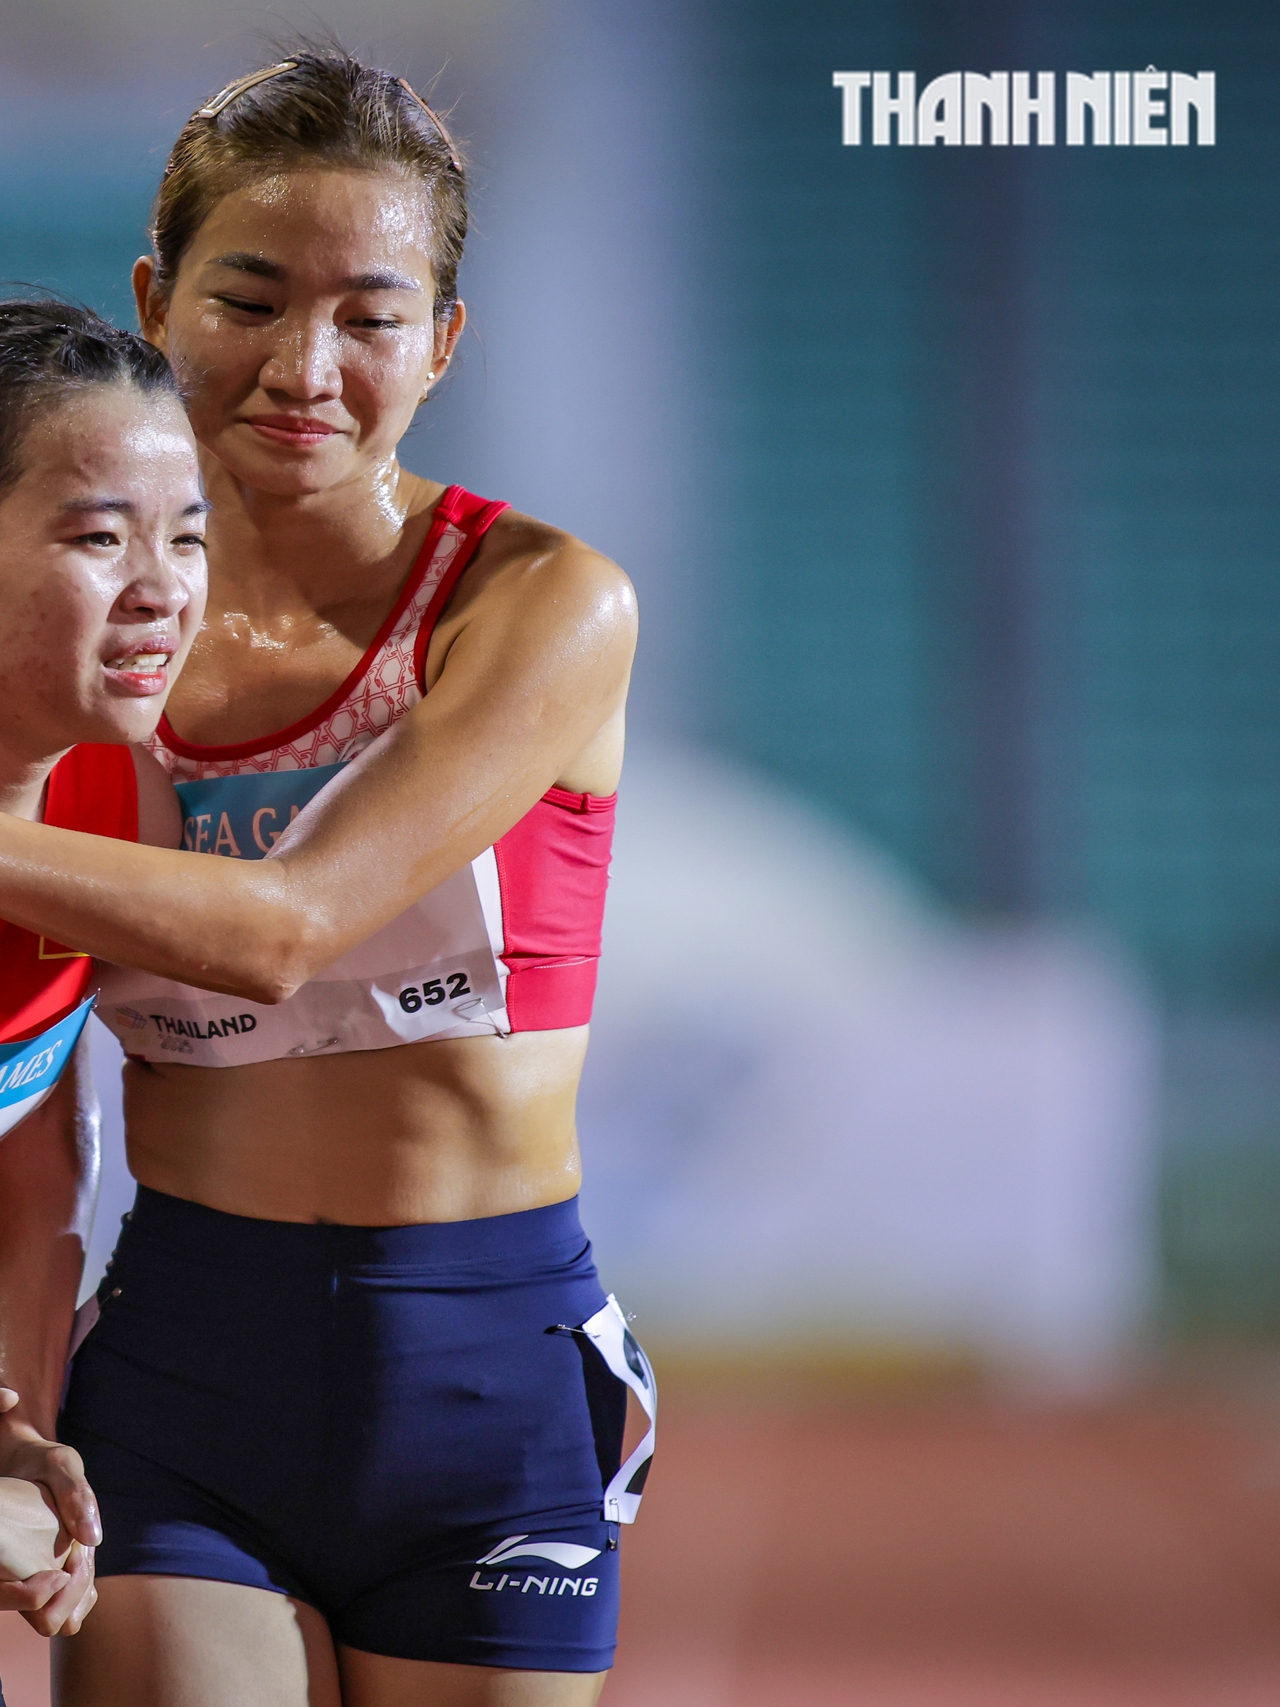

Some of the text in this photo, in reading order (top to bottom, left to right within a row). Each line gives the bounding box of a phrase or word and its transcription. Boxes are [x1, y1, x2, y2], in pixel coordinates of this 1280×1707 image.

[183, 811, 242, 857] SEA
[399, 973, 472, 1014] 652
[149, 1013, 257, 1040] THAILAND
[470, 1571, 599, 1597] LI-NING
